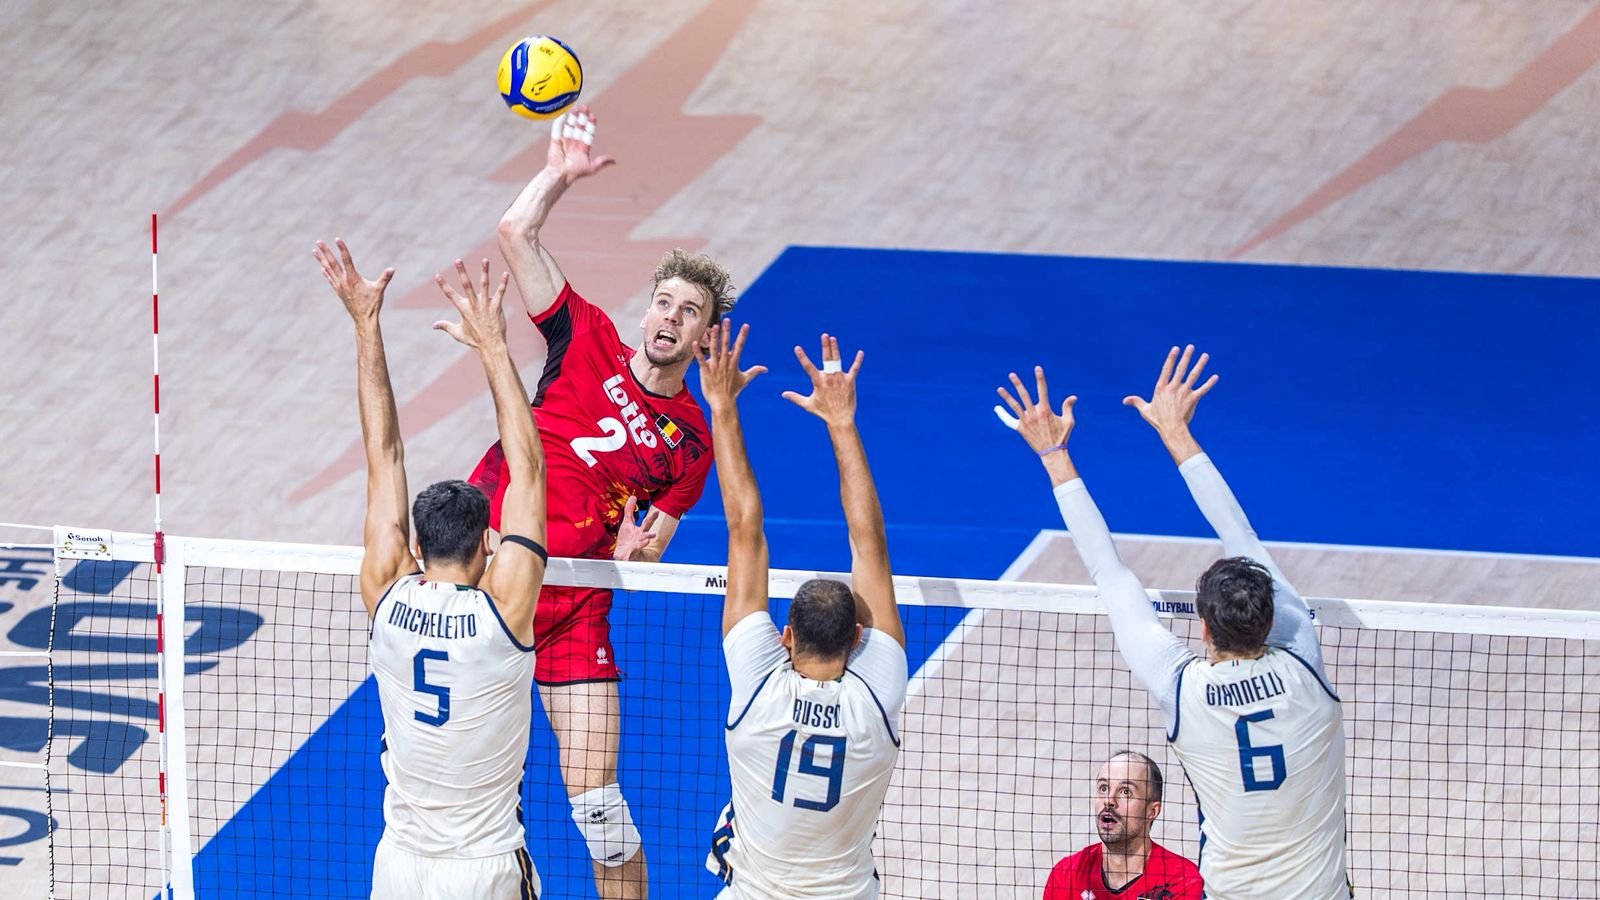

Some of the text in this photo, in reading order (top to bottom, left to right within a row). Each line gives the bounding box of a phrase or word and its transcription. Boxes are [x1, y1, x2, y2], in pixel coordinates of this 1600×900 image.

[570, 417, 627, 468] 2
[75, 534, 104, 542] Senoh
[1151, 601, 1195, 614] OLLEYBALL
[413, 648, 450, 727] 5
[1206, 672, 1286, 706] GIANNELLI
[792, 698, 841, 729] RUSSO
[771, 729, 847, 812] 19
[1235, 708, 1287, 792] 6
